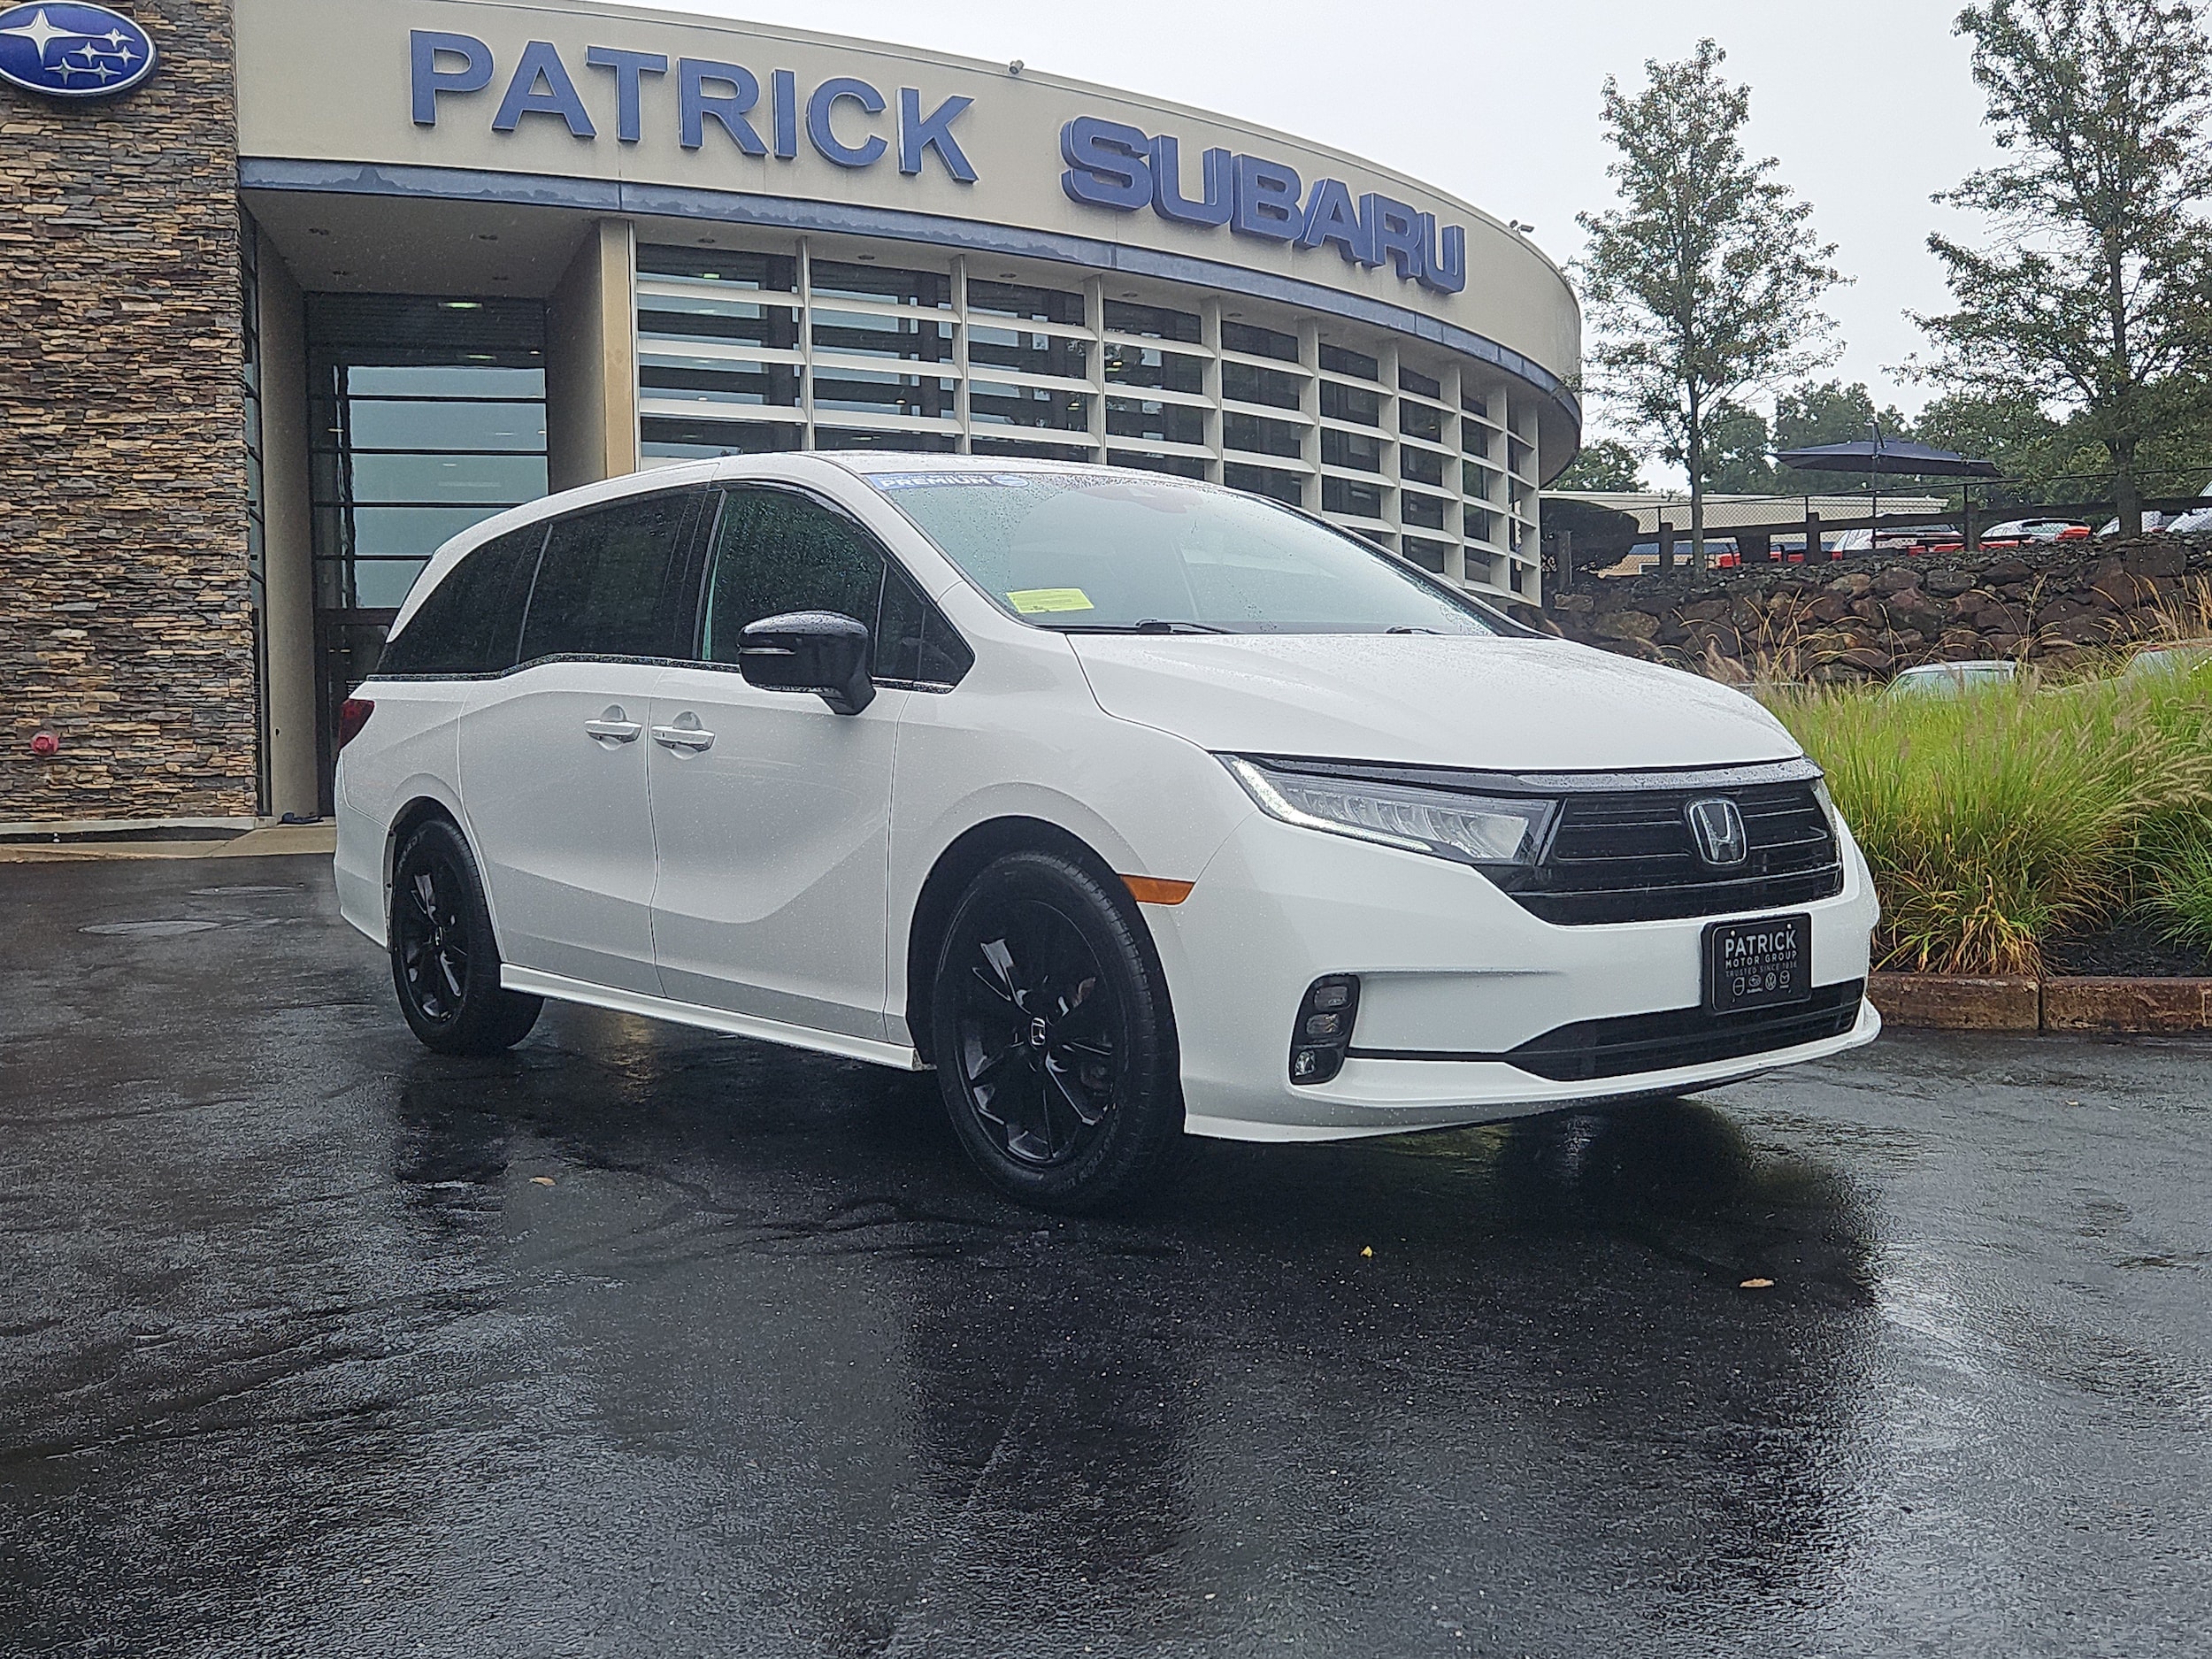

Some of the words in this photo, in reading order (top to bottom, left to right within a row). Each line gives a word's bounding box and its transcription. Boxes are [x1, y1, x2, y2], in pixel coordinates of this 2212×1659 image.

[410, 29, 979, 182] PATRICK
[1060, 114, 1466, 295] SUBARU
[879, 478, 992, 488] PREMIUM
[1725, 930, 1797, 958] PATRICK
[1725, 956, 1760, 970] MOTOR
[1764, 950, 1798, 964] GROUP
[1725, 966, 1757, 978] TRUSTED
[1760, 963, 1780, 973] SINCE
